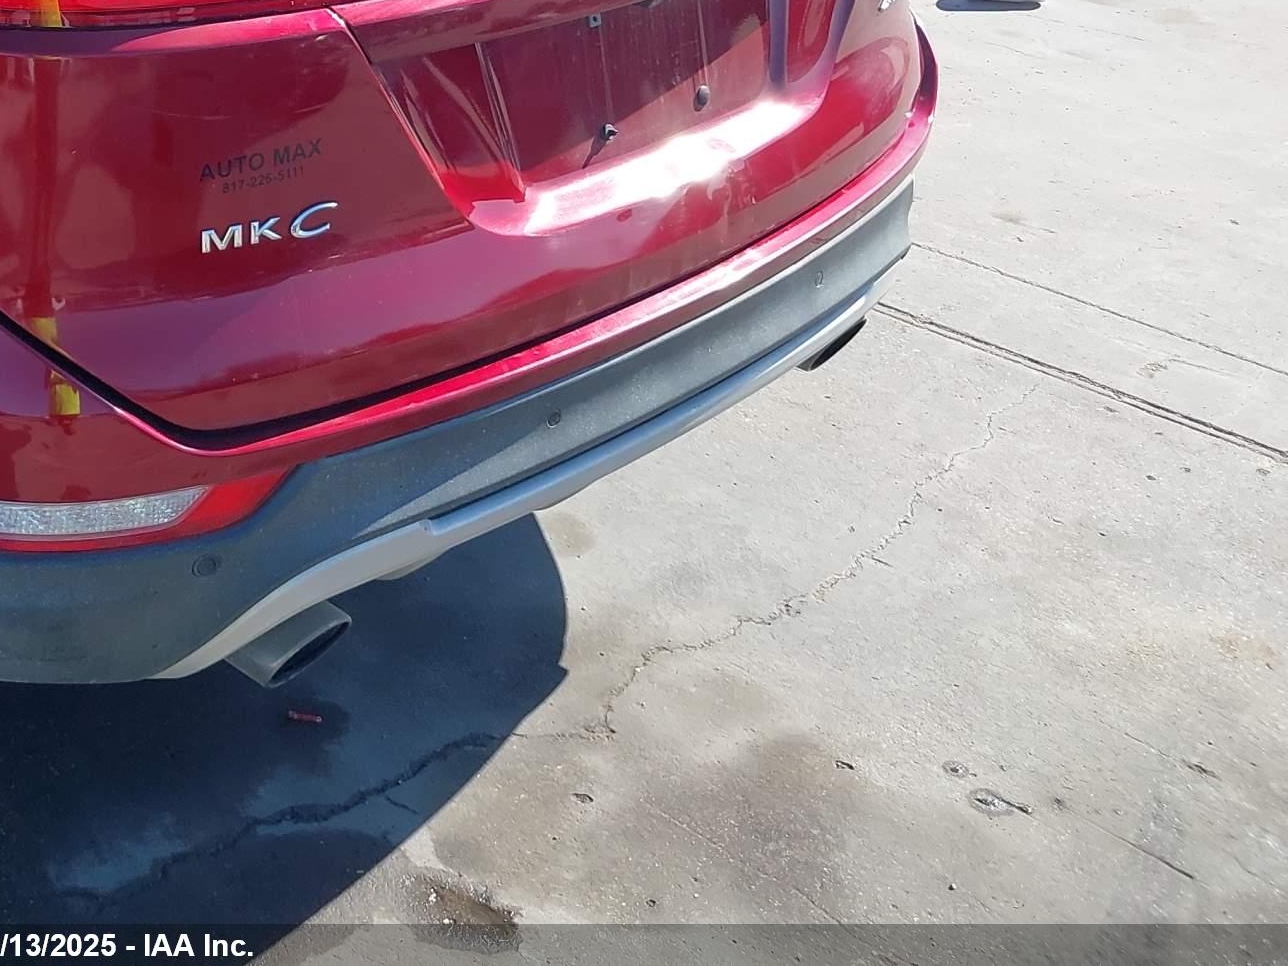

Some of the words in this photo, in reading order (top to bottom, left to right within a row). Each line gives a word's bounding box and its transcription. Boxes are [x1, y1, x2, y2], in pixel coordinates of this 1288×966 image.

[200, 153, 265, 181] AUTO
[273, 137, 323, 166] MAX
[201, 201, 339, 254] MKC
